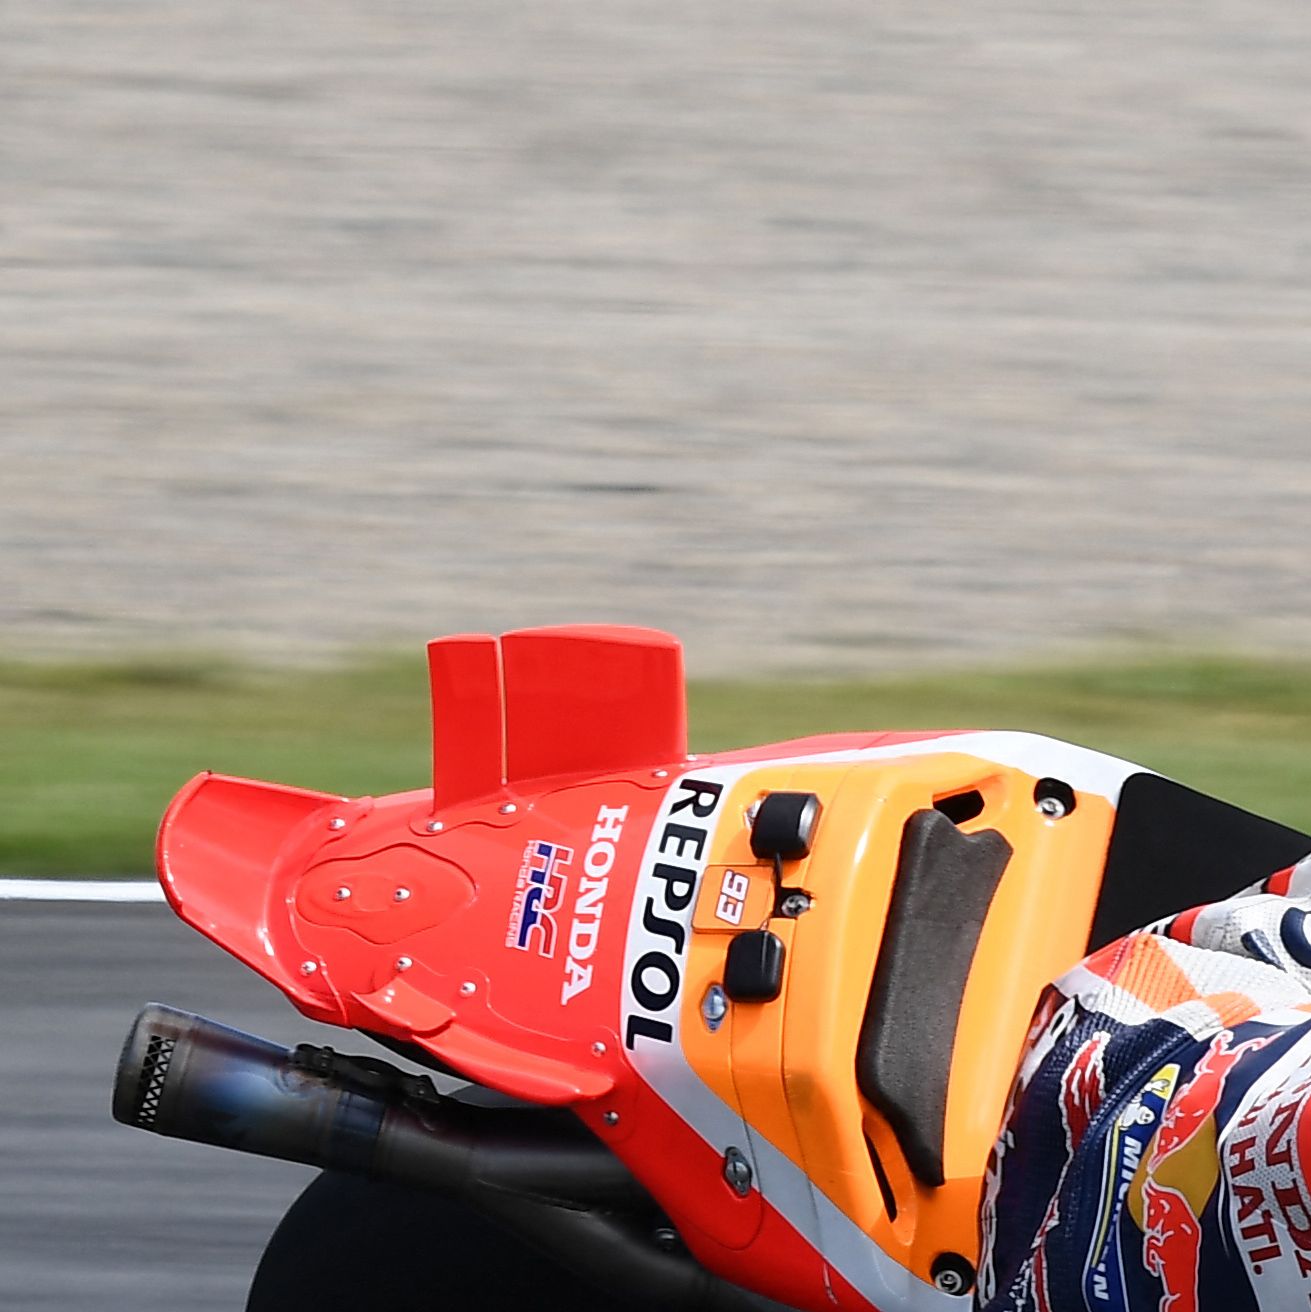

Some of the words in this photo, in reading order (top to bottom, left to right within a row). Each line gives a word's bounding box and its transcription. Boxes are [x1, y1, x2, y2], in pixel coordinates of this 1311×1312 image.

[514, 839, 575, 960] HRC
[560, 804, 629, 1006] HONDA
[625, 778, 725, 1051] REPSOL
[715, 868, 750, 927] 93
